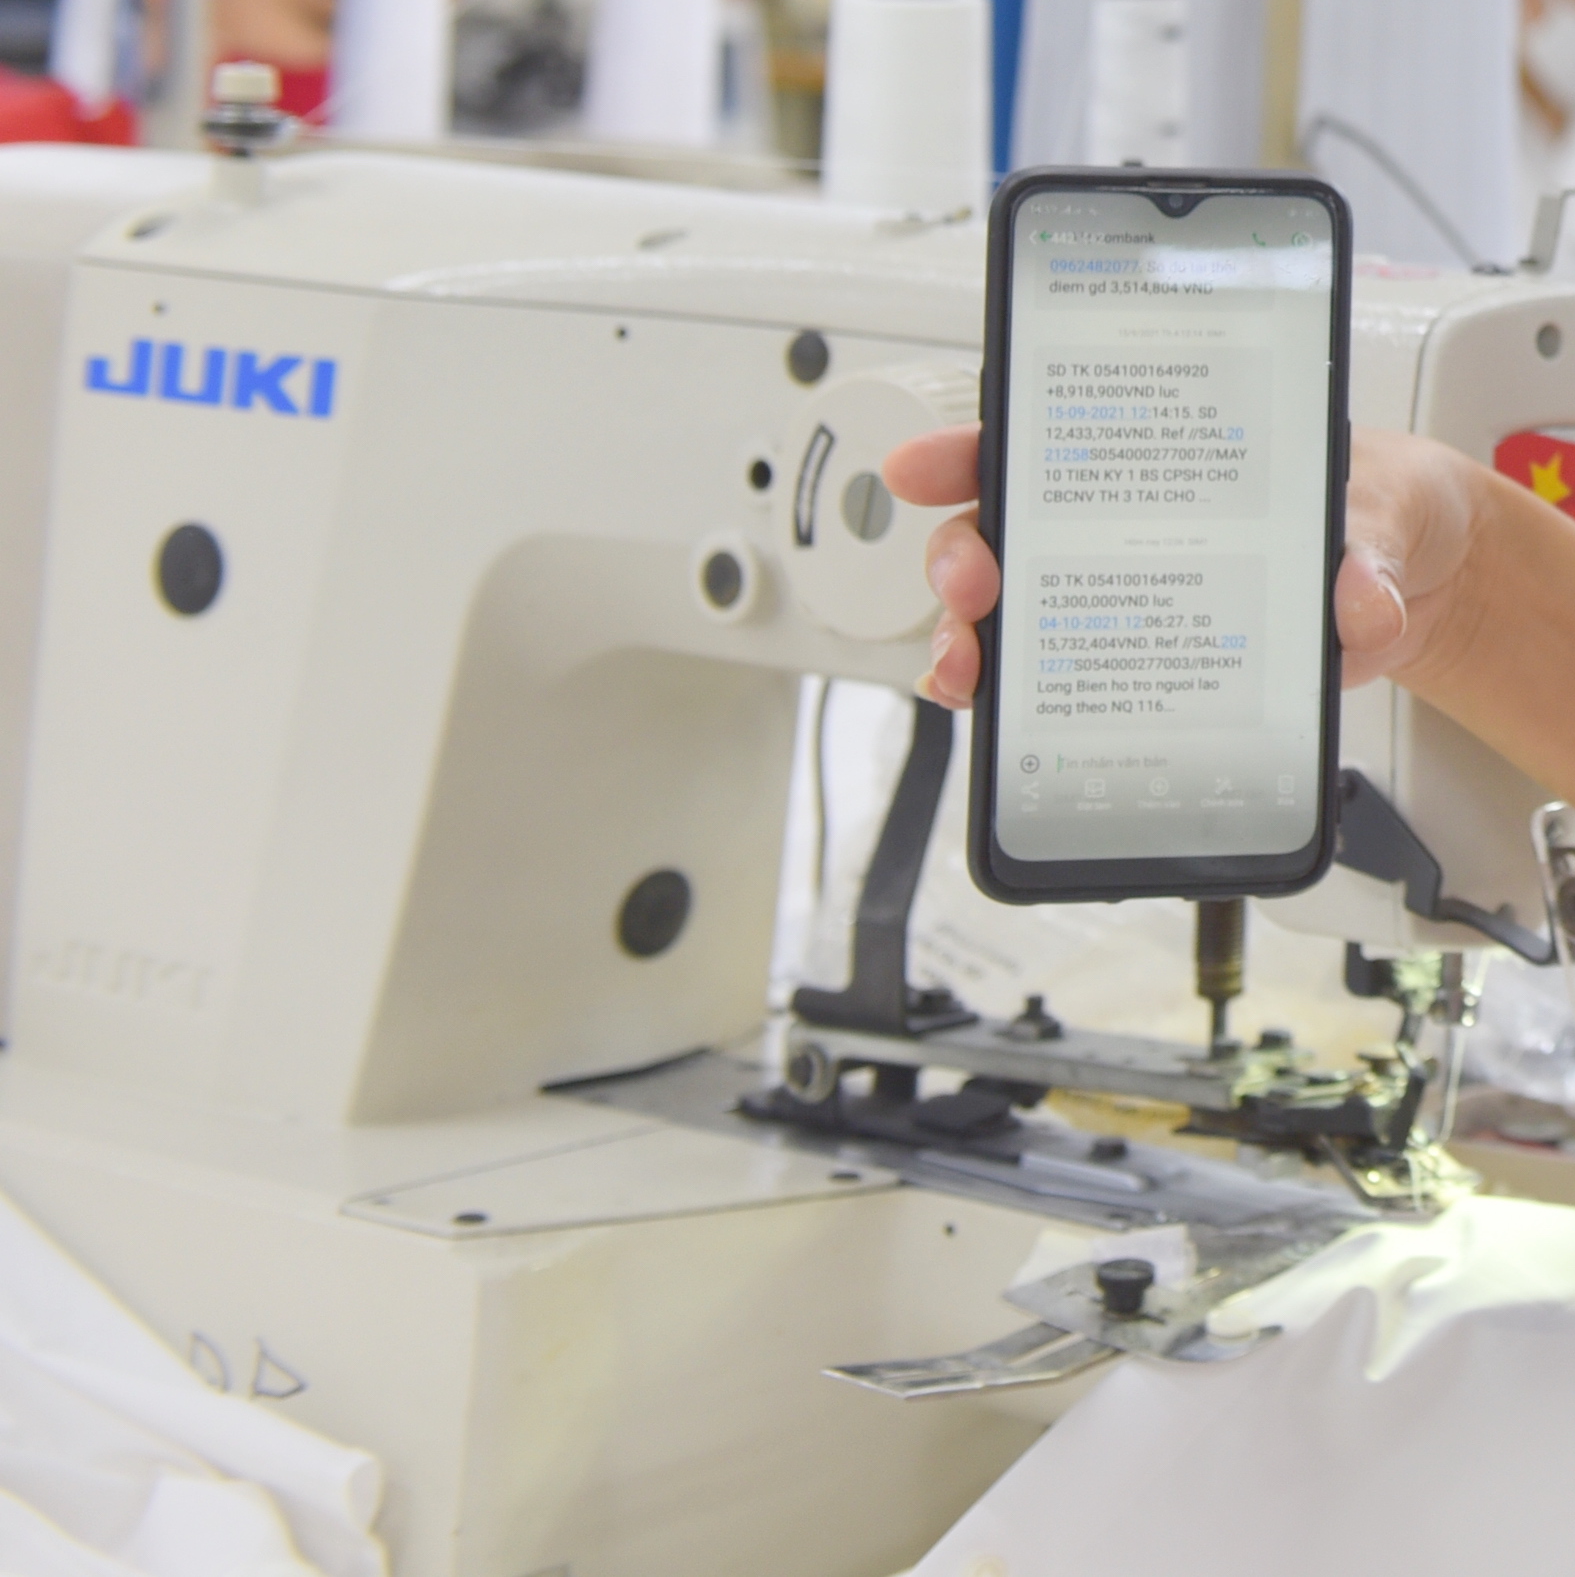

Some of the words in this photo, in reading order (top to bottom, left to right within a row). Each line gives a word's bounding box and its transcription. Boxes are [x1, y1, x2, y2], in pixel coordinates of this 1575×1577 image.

[1049, 282, 1084, 294] diem
[1089, 282, 1106, 296] gd
[1111, 282, 1178, 295] 3,514,804
[1184, 282, 1213, 294] VND
[1047, 365, 1066, 377] SD
[1071, 365, 1089, 377] TK
[1094, 365, 1209, 377] 0541001649920
[86, 338, 335, 418] JUKI
[1046, 385, 1154, 399] +8,918,900VND
[1159, 385, 1180, 398] luc
[1047, 407, 1125, 419] 15-09-2021
[1198, 407, 1218, 419] SD
[1161, 427, 1184, 440] Ref
[1045, 470, 1062, 482] 10
[1066, 470, 1100, 482] TIEN
[1103, 470, 1122, 482] KY
[1128, 470, 1135, 482] 1
[1140, 470, 1159, 482] BS
[1163, 470, 1203, 482] CPSH
[1207, 470, 1239, 482] CHO
[1043, 491, 1095, 503] CBCNV
[1099, 491, 1119, 503] TH
[1123, 491, 1132, 503] 3
[1138, 491, 1159, 503] TAI
[1164, 491, 1195, 503] CHO
[1041, 574, 1060, 587] SD
[1066, 574, 1083, 587] TK
[1088, 574, 1203, 587] 0541001649920
[1040, 595, 1149, 609] +3,300,000VND
[1153, 595, 1174, 607] luc
[1039, 616, 1119, 630] 04-10-2021
[1192, 615, 1212, 627] SD
[1155, 637, 1178, 649] Ref
[1038, 681, 1072, 694] Long
[1077, 679, 1107, 693] Bien
[1111, 679, 1129, 692] ho
[1133, 680, 1151, 692] tro
[1156, 678, 1194, 694] nguoi
[1199, 678, 1220, 691] lao
[1036, 701, 1072, 716] dong
[1076, 701, 1107, 715] theo
[1111, 701, 1133, 715] NQ
